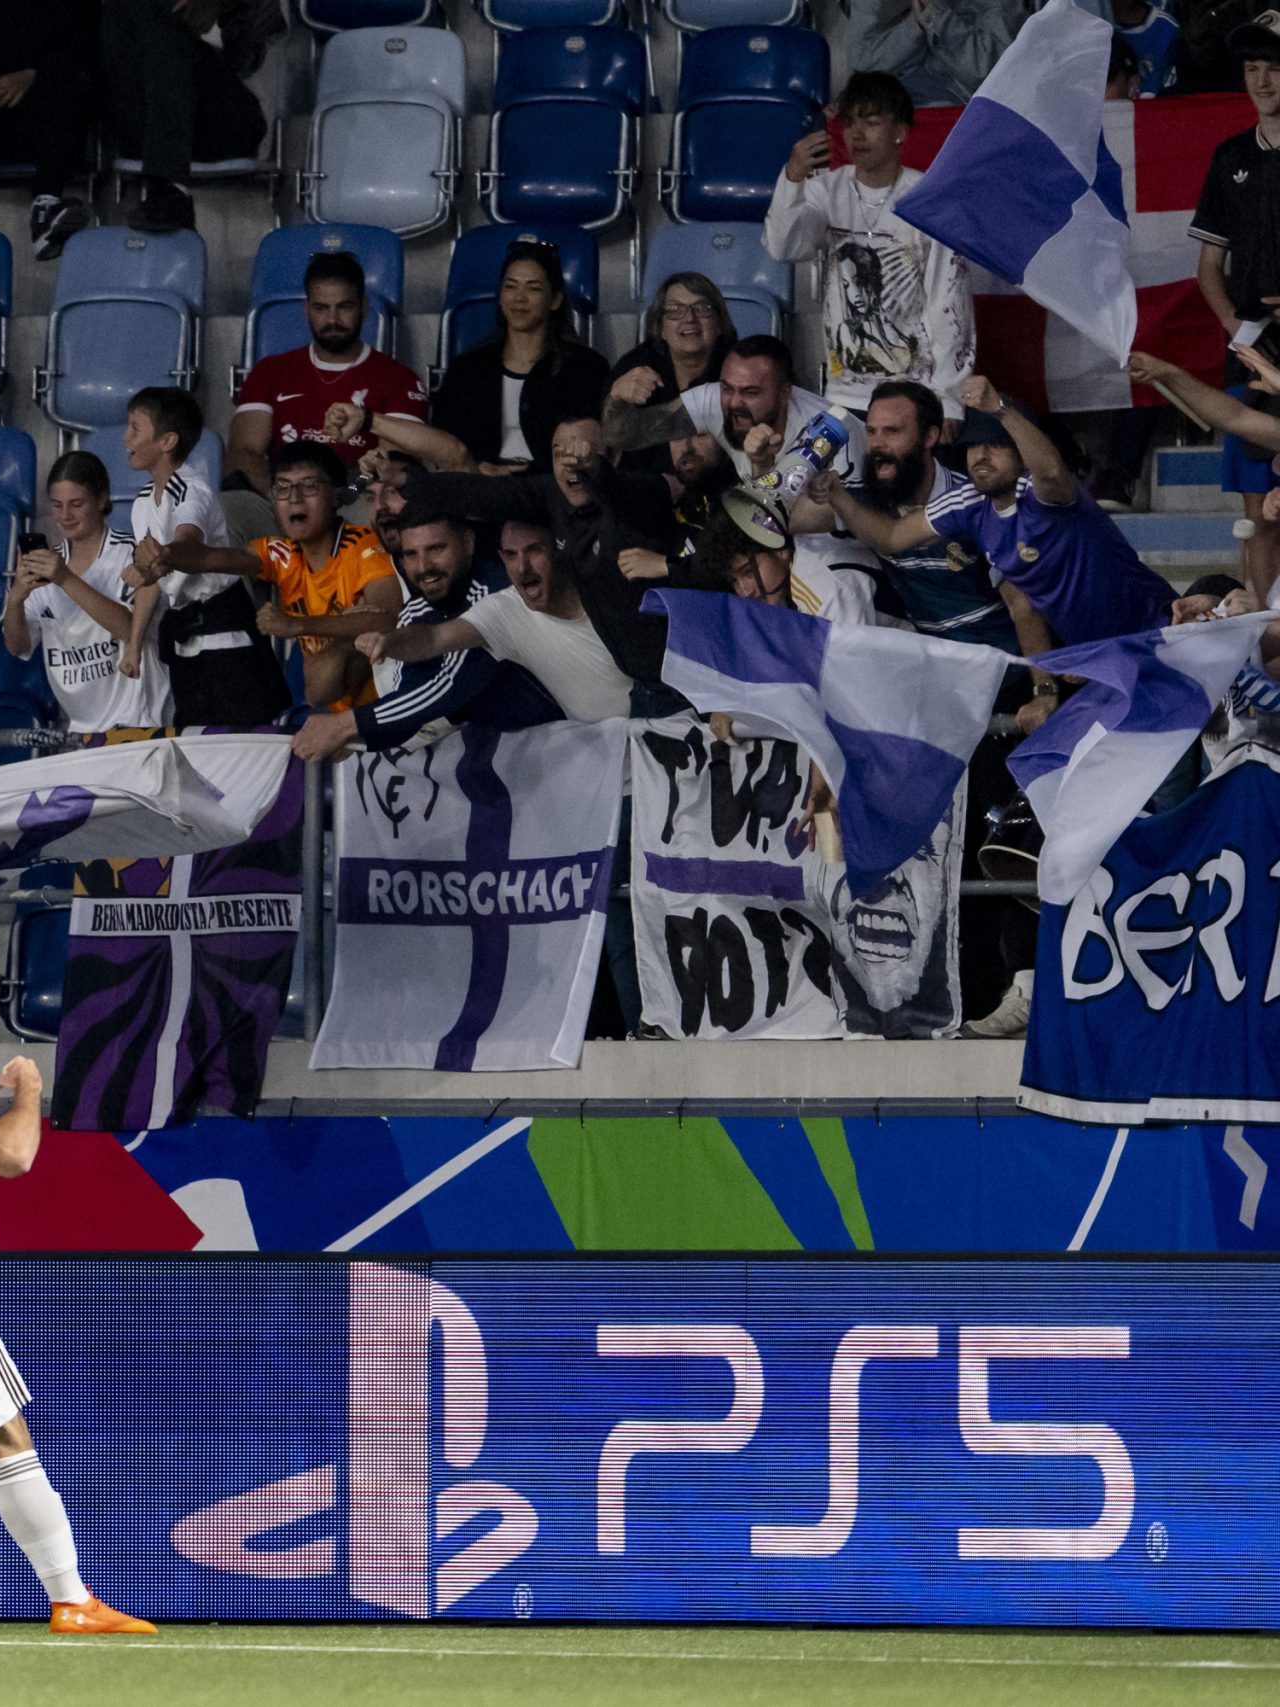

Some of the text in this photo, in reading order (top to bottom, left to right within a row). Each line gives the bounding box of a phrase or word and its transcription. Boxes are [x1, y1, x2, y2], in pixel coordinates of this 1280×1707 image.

[47, 639, 120, 667] Emirates
[63, 660, 115, 685] FLY BETTER
[368, 862, 599, 916] RORSCHACH
[126, 902, 207, 931] MADRIDISTA
[208, 898, 293, 929] PRESENTE
[1061, 848, 1280, 1011] BER
[597, 1324, 1136, 1561] PS5
